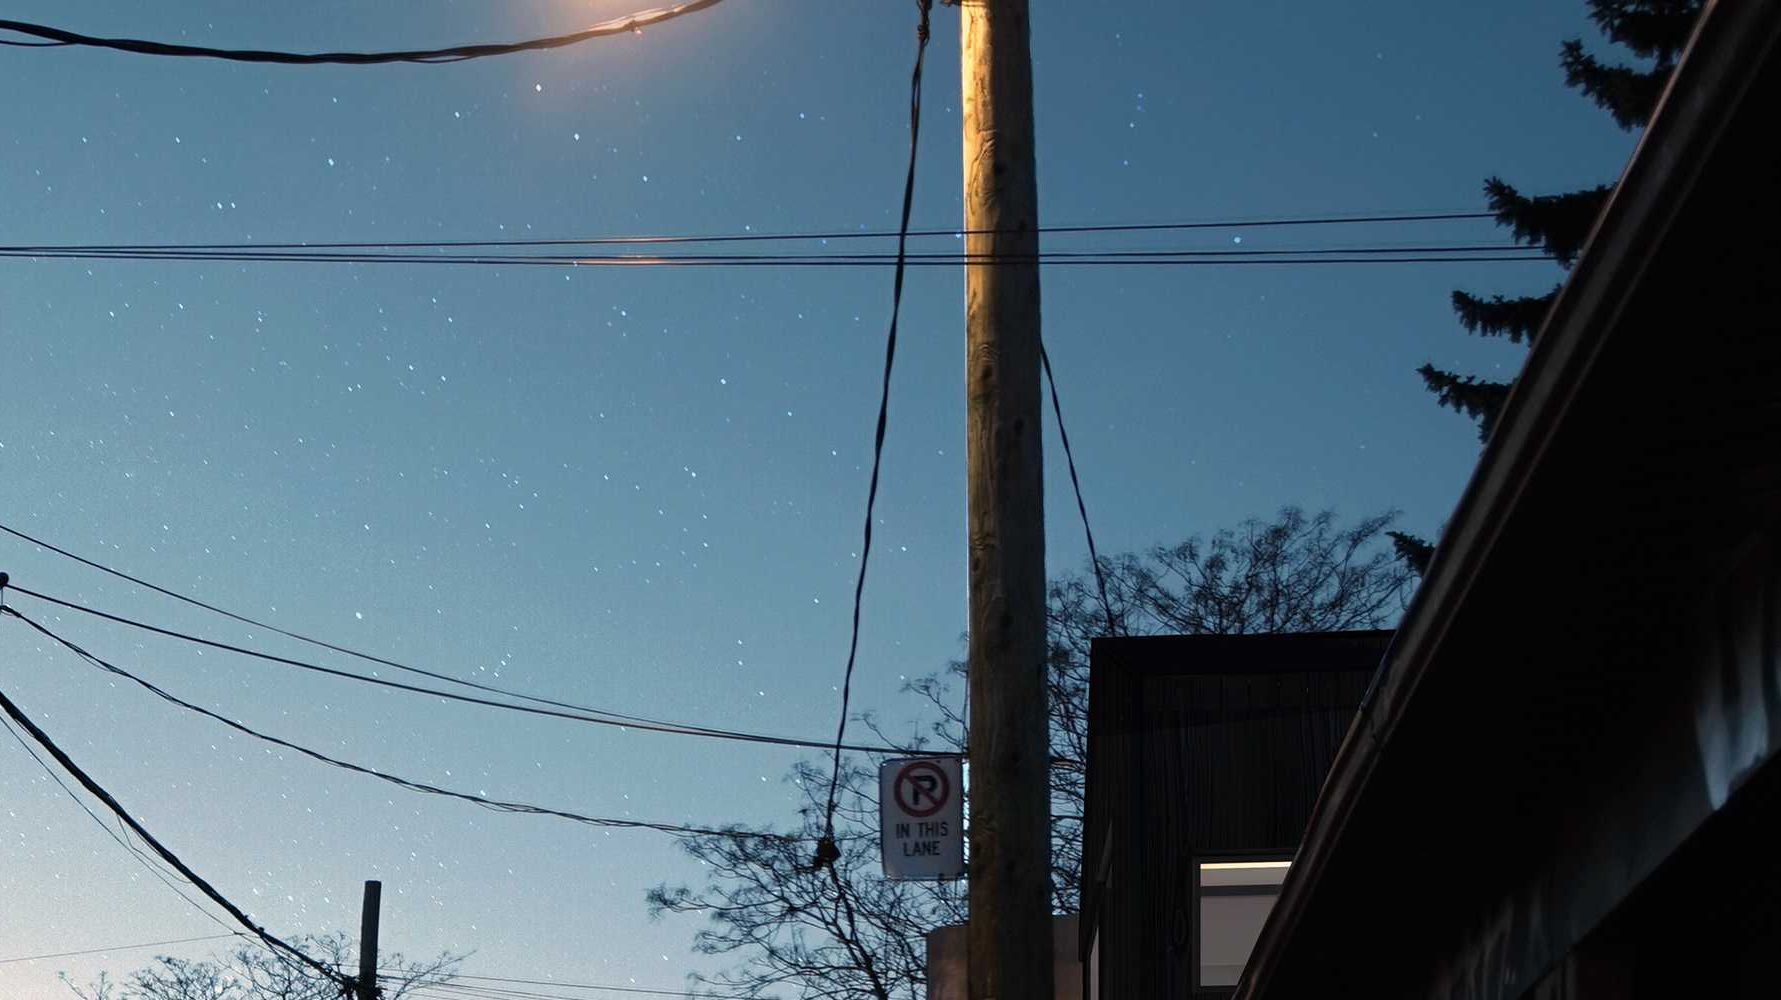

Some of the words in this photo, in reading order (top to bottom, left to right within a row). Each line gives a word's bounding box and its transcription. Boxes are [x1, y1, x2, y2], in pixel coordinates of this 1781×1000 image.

[912, 775, 938, 805] P
[896, 823, 910, 839] IN
[916, 821, 949, 838] THIS
[903, 841, 941, 857] LANE
